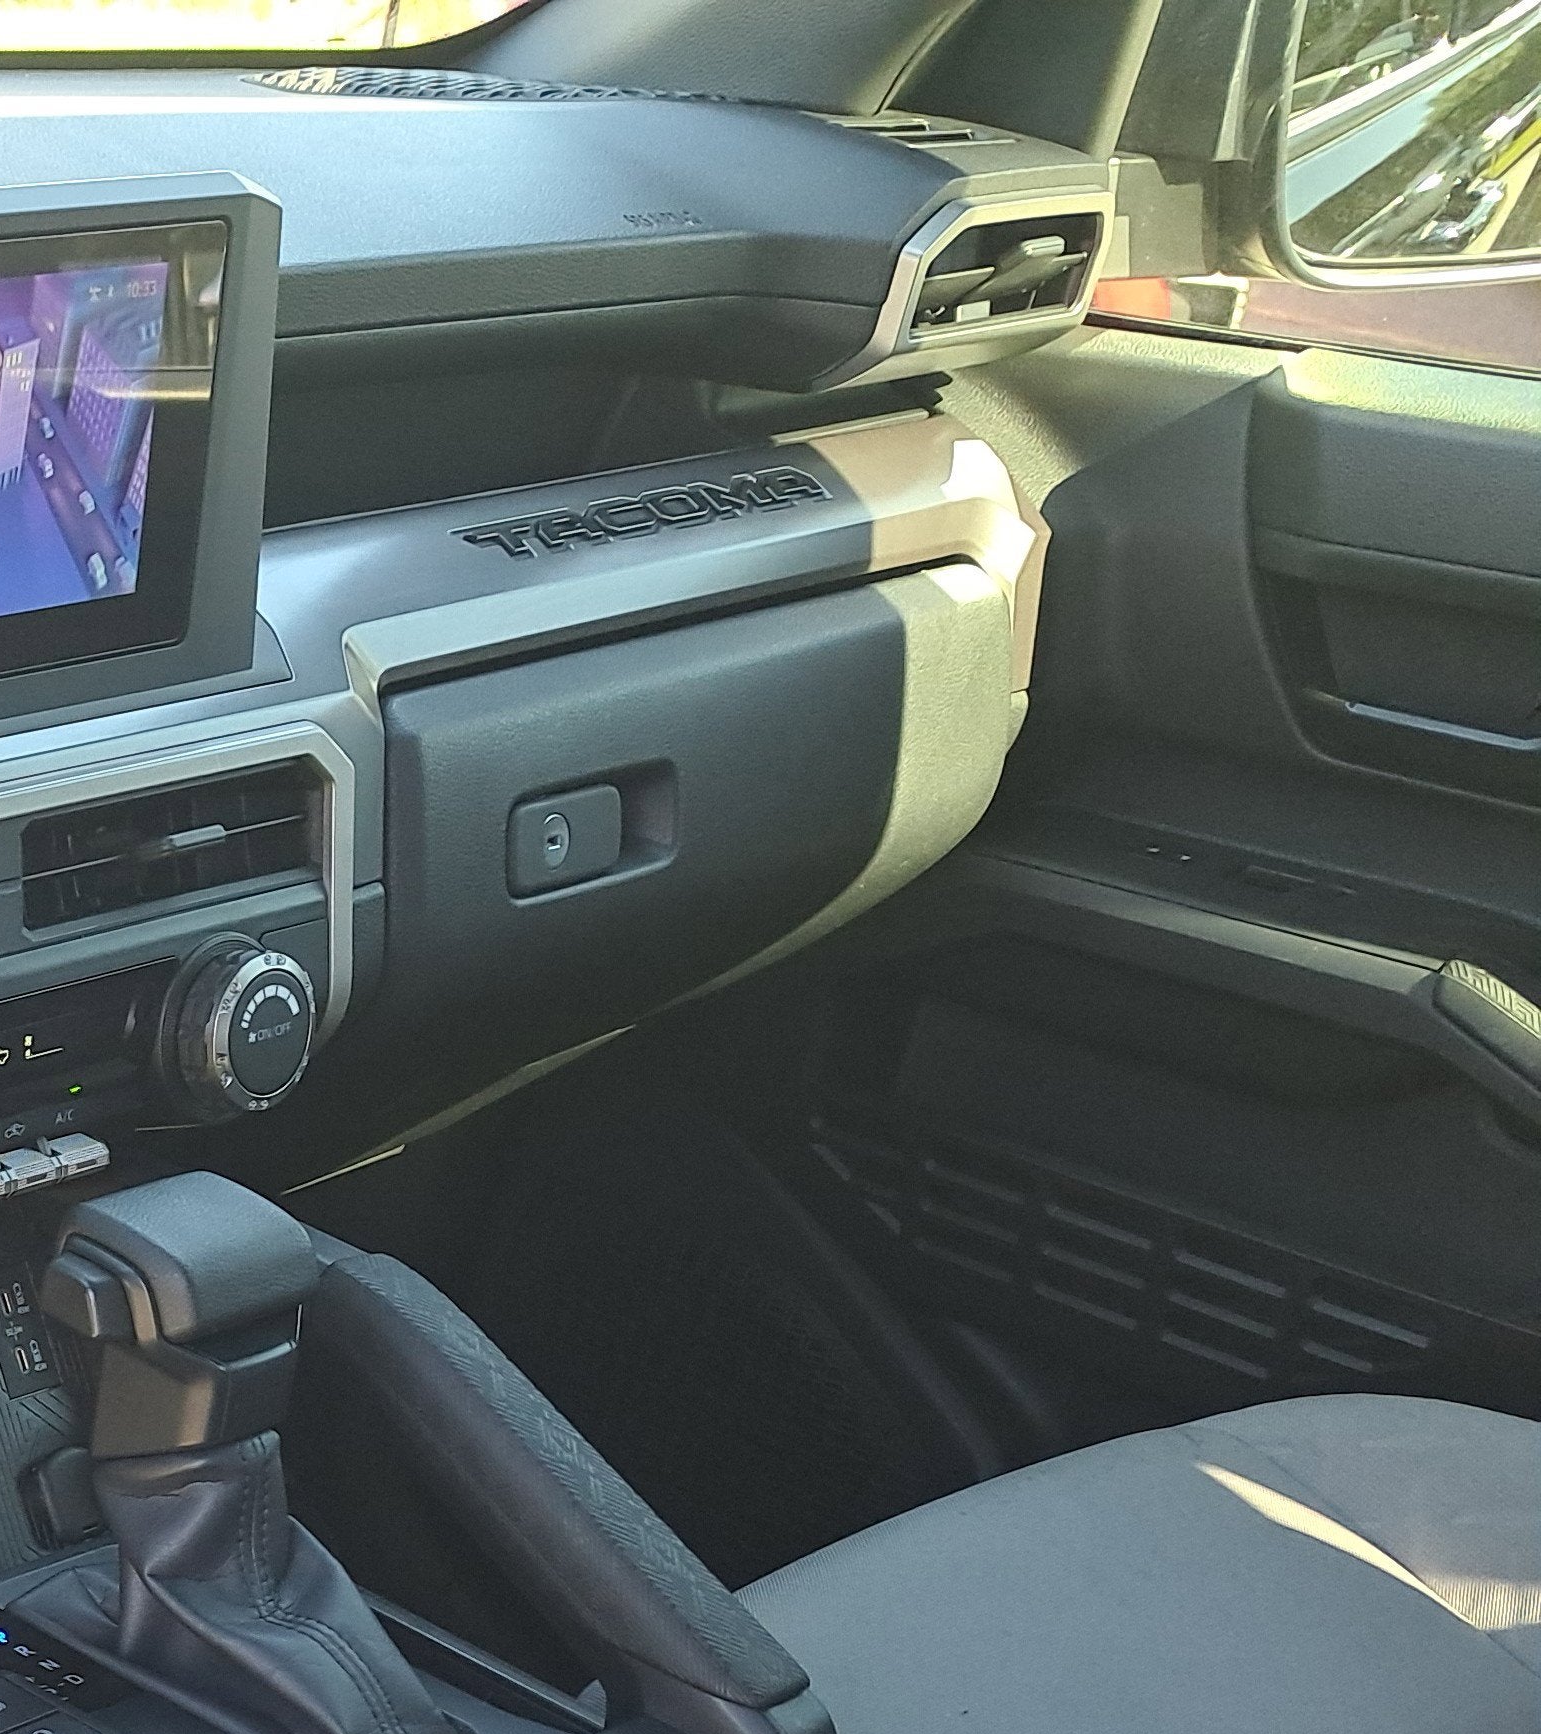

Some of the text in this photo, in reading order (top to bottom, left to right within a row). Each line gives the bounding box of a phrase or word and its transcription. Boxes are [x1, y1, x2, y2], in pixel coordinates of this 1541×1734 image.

[448, 465, 833, 560] TACOMA
[55, 1109, 74, 1124] A/C
[13, 1645, 37, 1657] R
[63, 1674, 85, 1685] D
